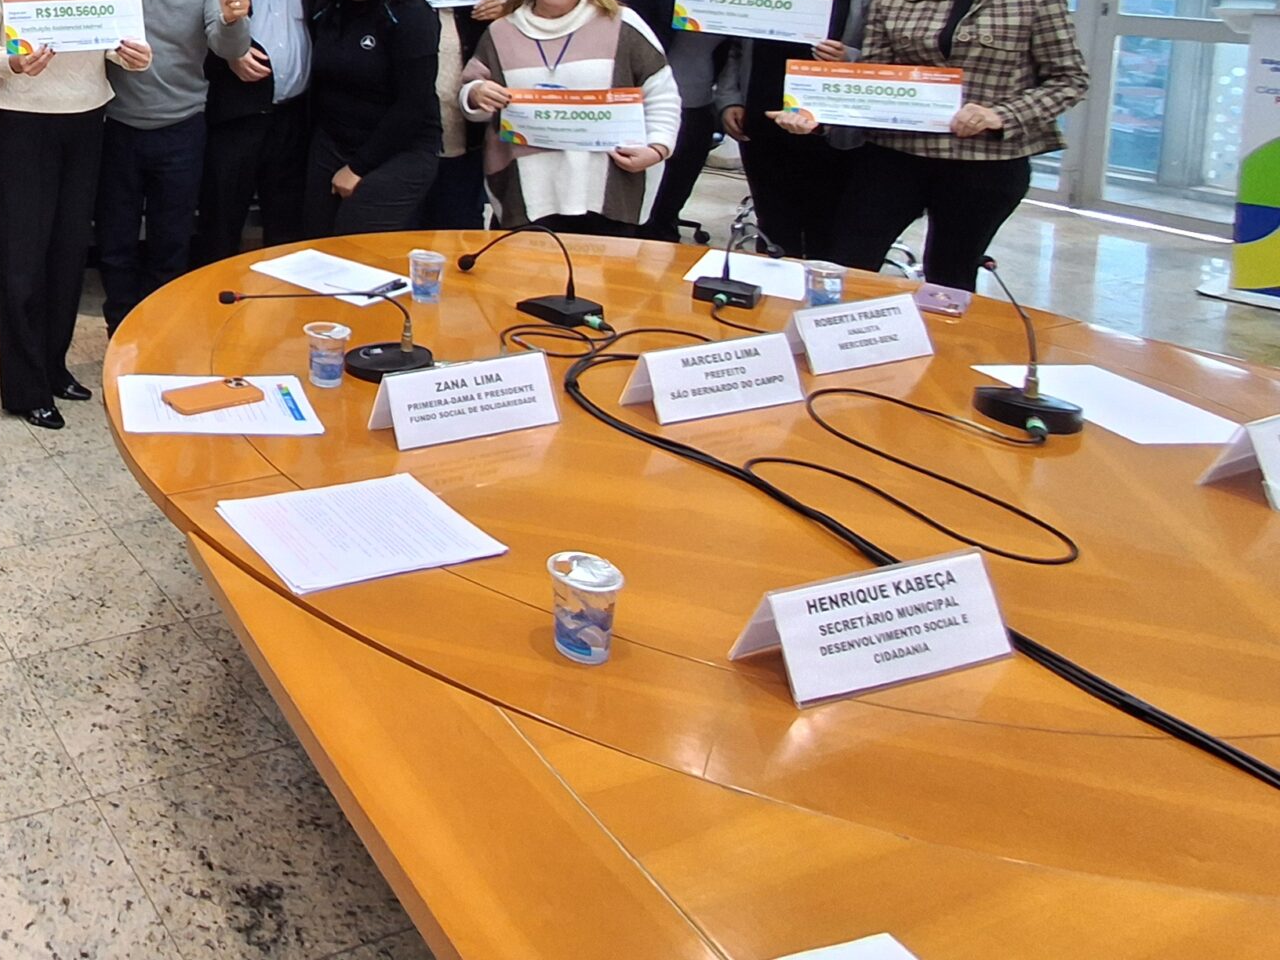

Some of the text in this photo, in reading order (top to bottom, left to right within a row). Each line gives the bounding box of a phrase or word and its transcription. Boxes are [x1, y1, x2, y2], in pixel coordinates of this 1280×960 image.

[35, 7, 51, 19] R$
[53, 5, 115, 19] 190.560,00
[821, 82, 842, 94] R$
[843, 83, 917, 99] 39.600,00
[534, 110, 551, 120] R$
[553, 110, 612, 122] 72.000,00
[814, 306, 902, 328] ROBERTA FRABETTI
[681, 347, 761, 368] MARCELO LIMA
[435, 372, 503, 393] ZANA LIMA
[704, 366, 747, 380] PREFEITO
[670, 374, 785, 400] SÃO BERNARDO DO CAMPO
[407, 393, 476, 412] PRIMEIRA-DAMA
[484, 384, 535, 399] PRESIDENTE
[409, 395, 537, 424] FUNDO SOCIAL DE SOLIDARIEDADE
[806, 569, 957, 616] HENRIQUE KABEÇA
[818, 596, 960, 637] SECRETÁRIO MUNICIPAL
[819, 613, 969, 657] DESENVOLVIMENTO SOCIAL E
[873, 643, 931, 664] CIDADANIA
